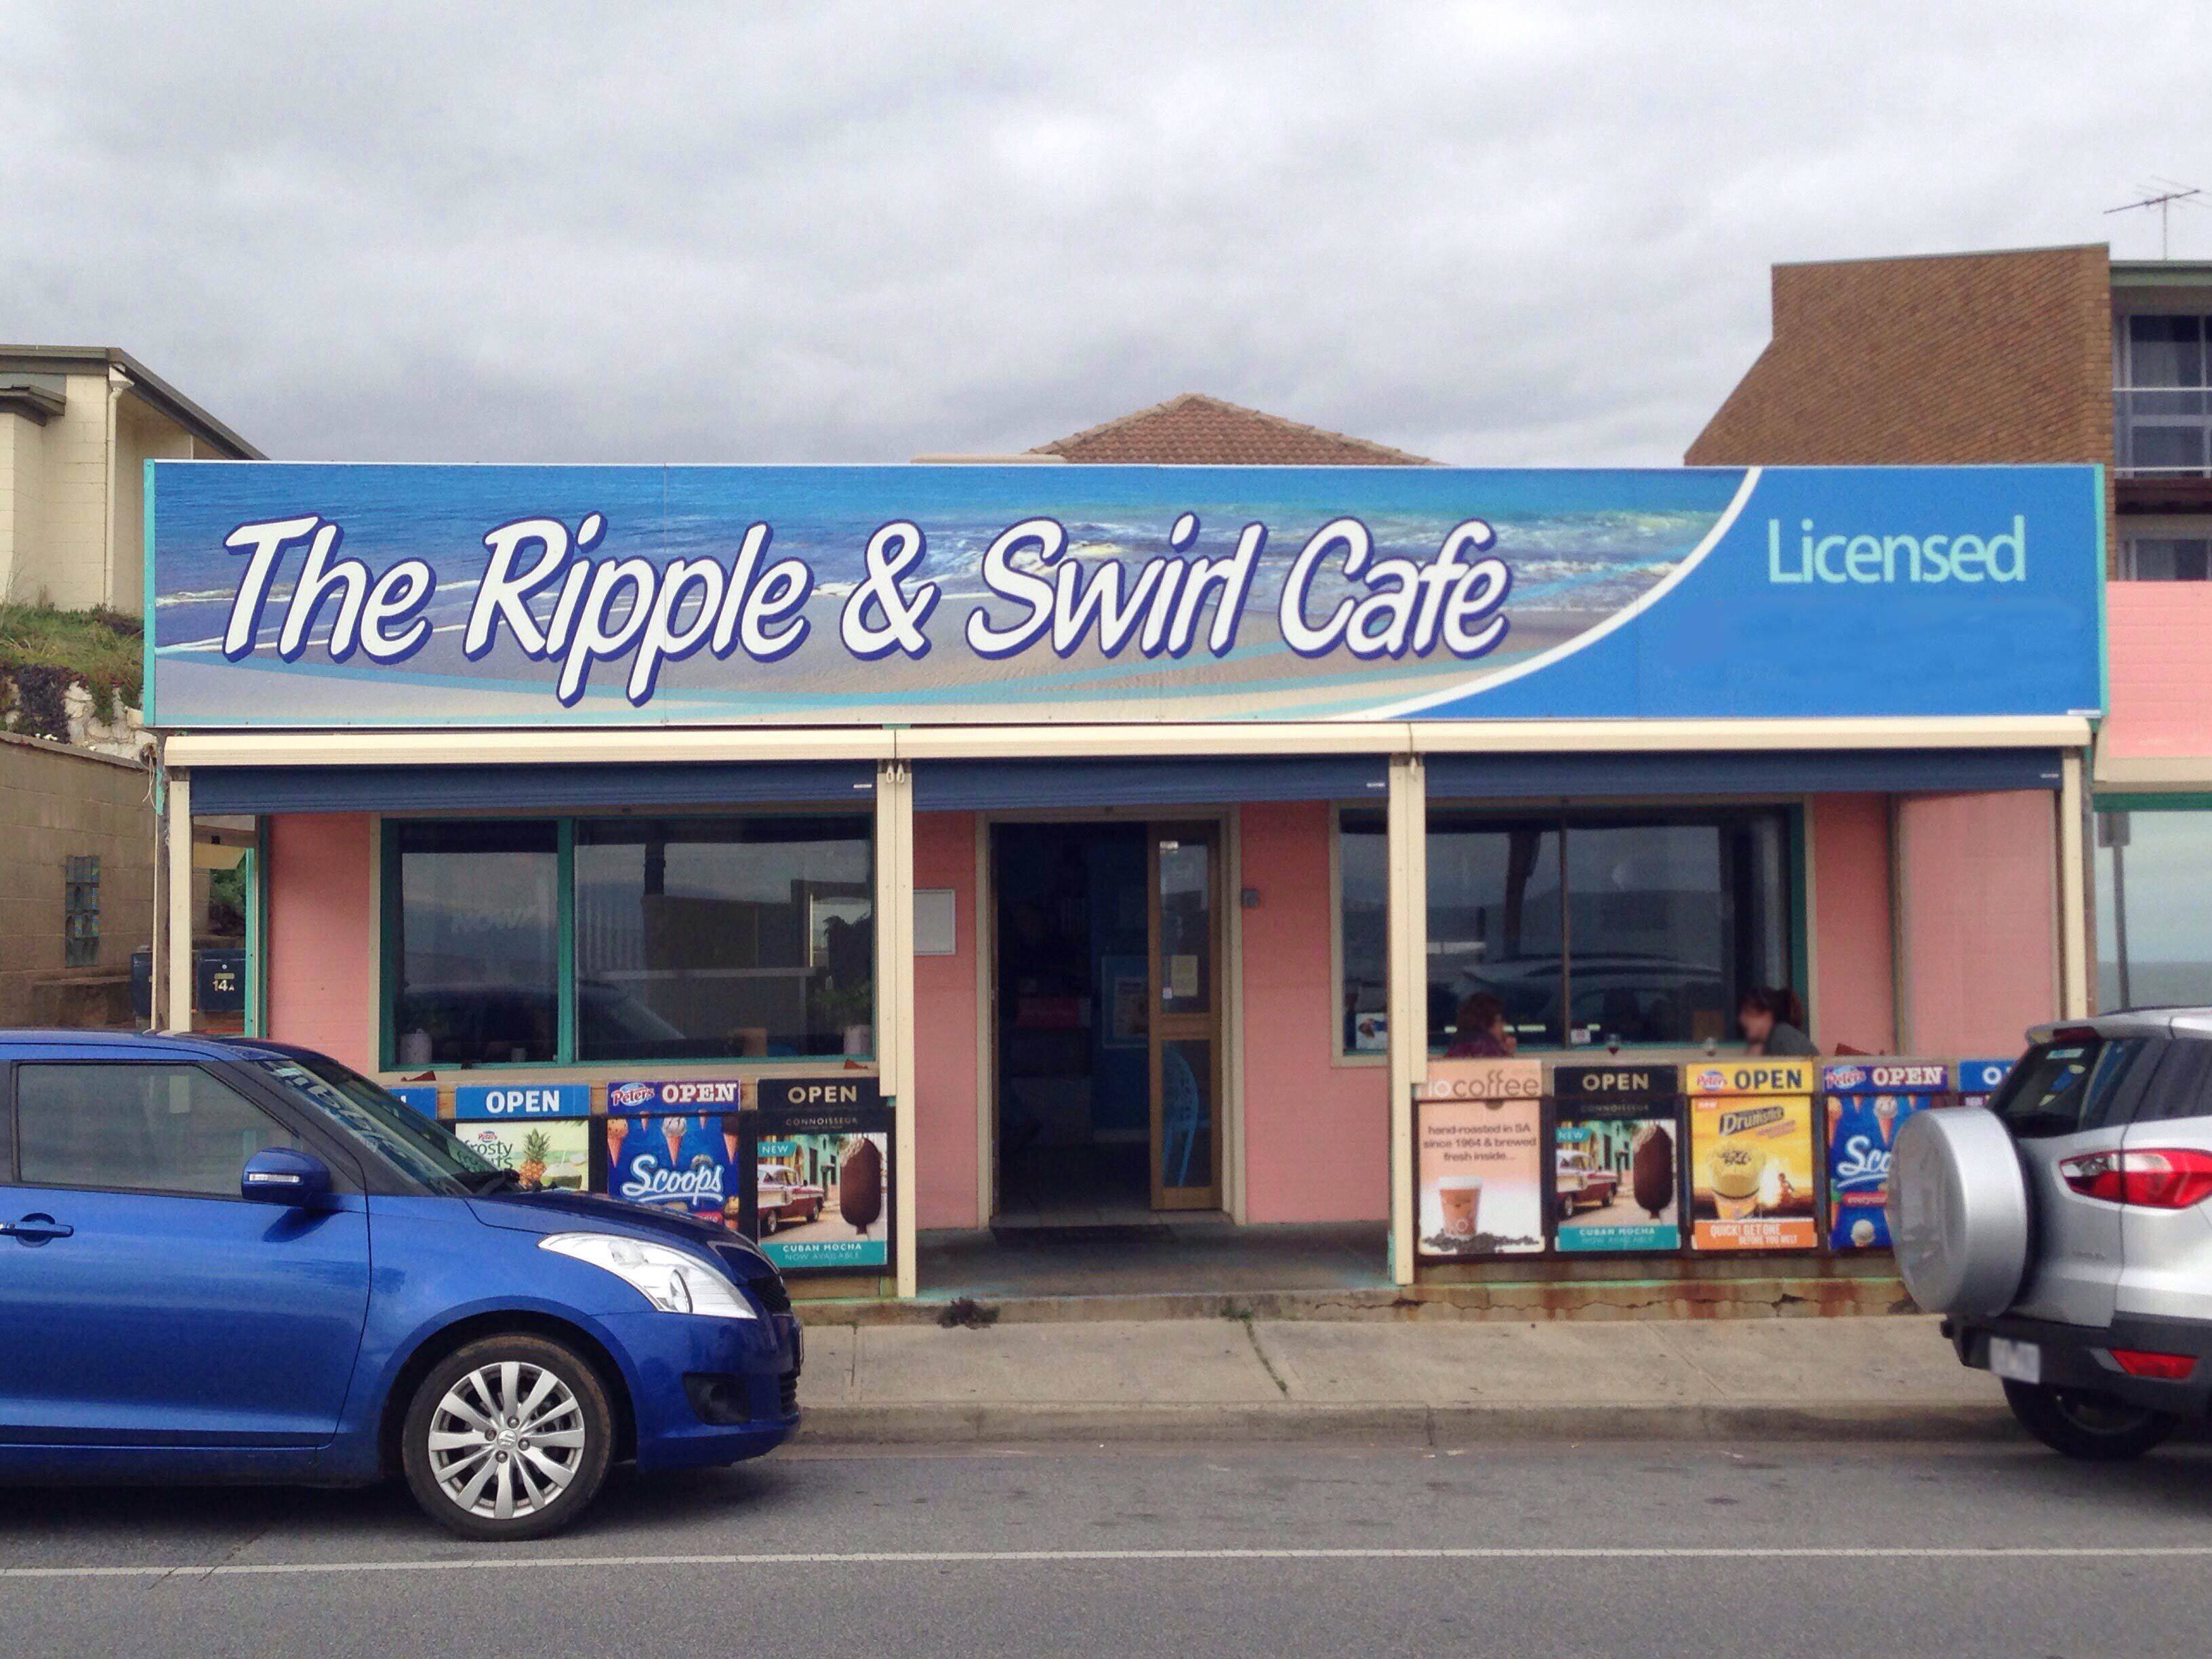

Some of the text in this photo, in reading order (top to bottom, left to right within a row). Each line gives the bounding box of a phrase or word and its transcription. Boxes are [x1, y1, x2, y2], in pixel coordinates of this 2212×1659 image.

[1768, 514, 2026, 583] Licensed
[223, 511, 1511, 707] The Ripple & Swirl Cafe
[1582, 1073, 1650, 1092] OPEN
[1734, 1069, 1802, 1090] OPEN
[1872, 1067, 1944, 1086] OPEN
[485, 1090, 560, 1113] OPEN
[662, 1083, 737, 1104] OPEN
[787, 1085, 858, 1104] OPEN
[785, 1118, 858, 1126] CONNOISSEUR
[762, 1145, 789, 1155] NEW
[622, 1155, 724, 1206] Scoops
[782, 1243, 862, 1253] CUBAN MOCHA
